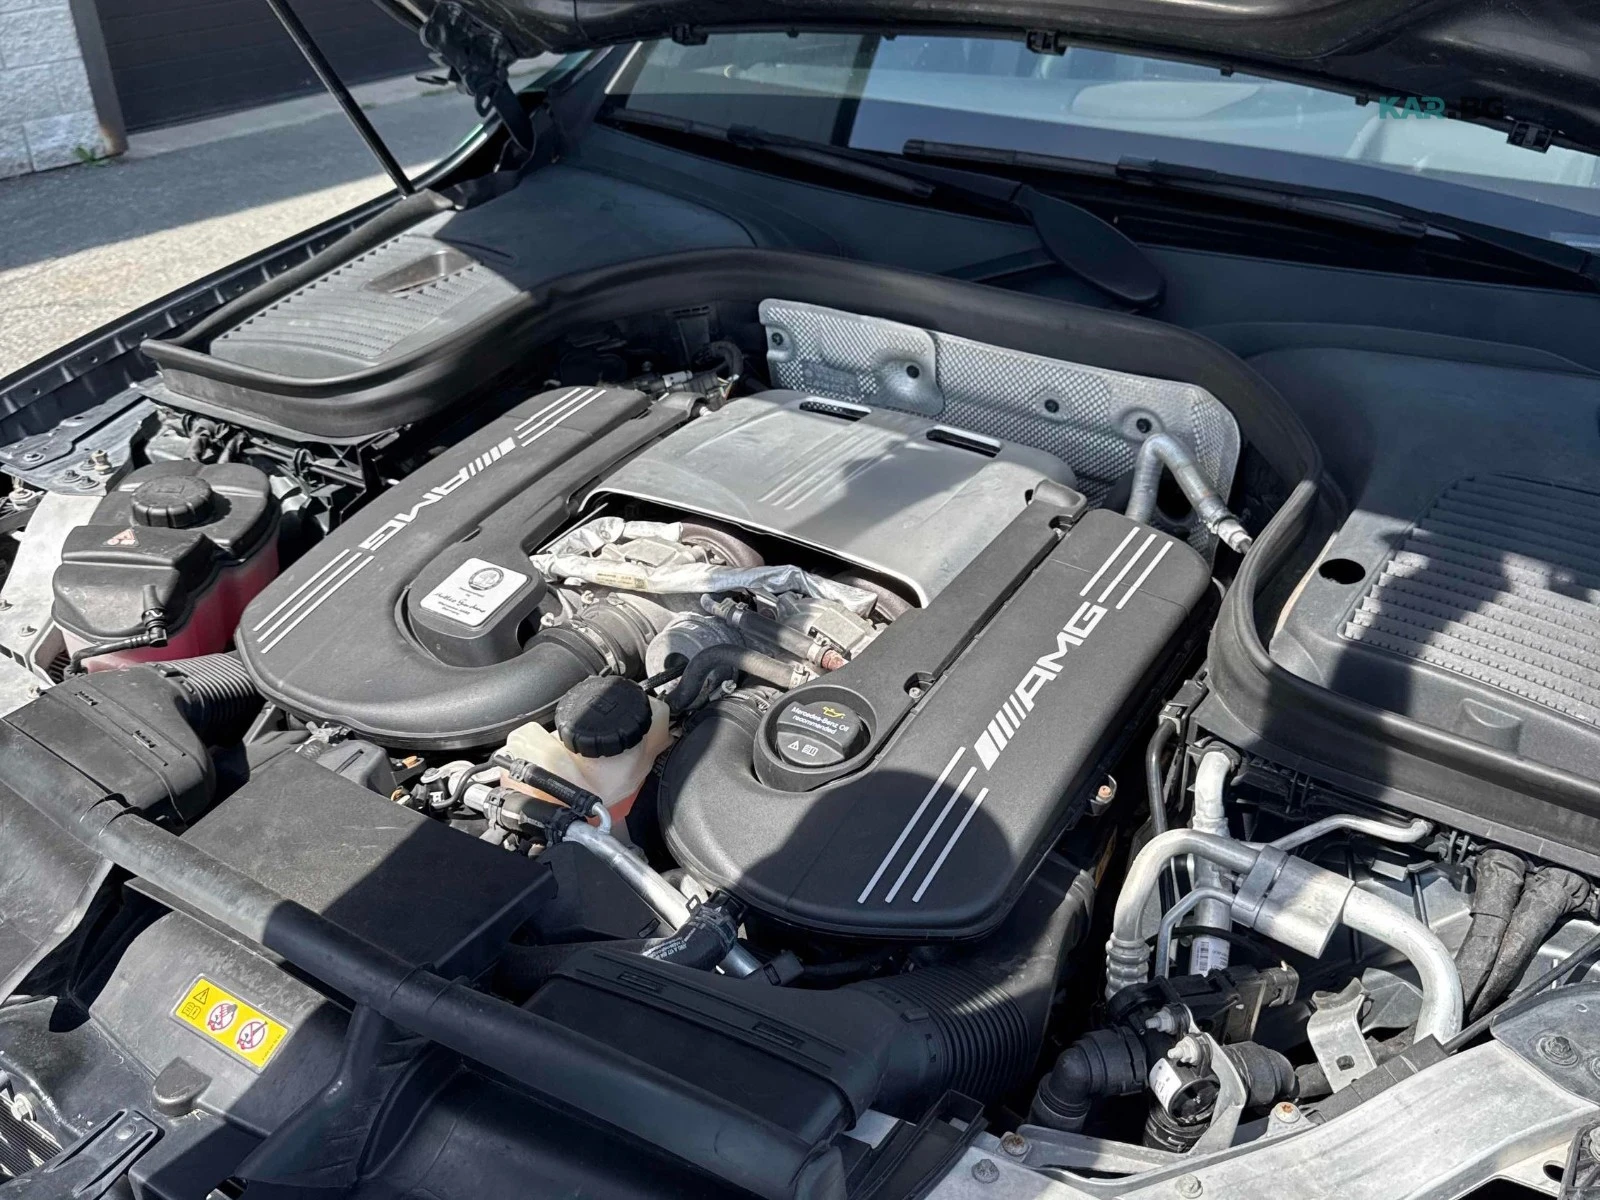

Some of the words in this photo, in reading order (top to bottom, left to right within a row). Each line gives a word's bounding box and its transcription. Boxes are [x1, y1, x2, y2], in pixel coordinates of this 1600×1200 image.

[358, 467, 470, 550] AMG
[1014, 601, 1108, 712] AMG
[791, 706, 839, 728] Mercedes-Benz
[792, 715, 838, 735] recommended
